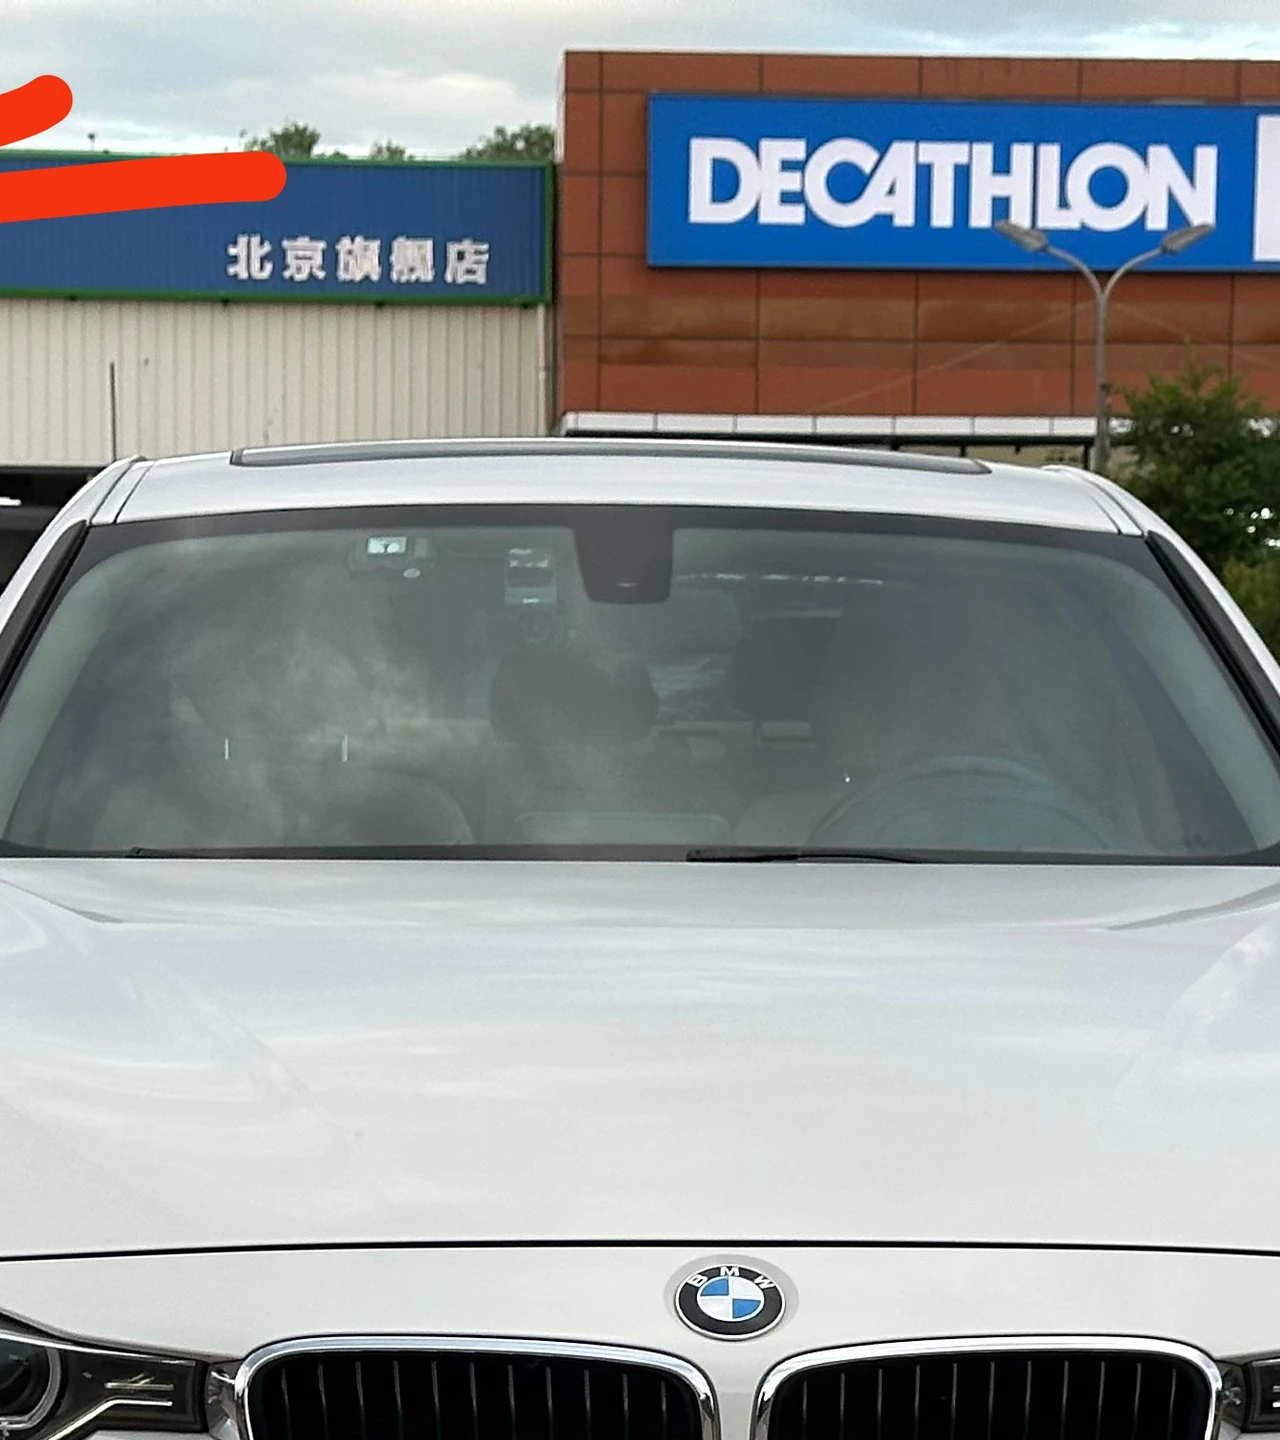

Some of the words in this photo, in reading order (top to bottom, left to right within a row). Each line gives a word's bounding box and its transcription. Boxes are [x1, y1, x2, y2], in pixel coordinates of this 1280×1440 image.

[688, 137, 1220, 231] DECATHLON
[226, 233, 490, 285] 北京旗舰店
[686, 1266, 777, 1290] BMW
